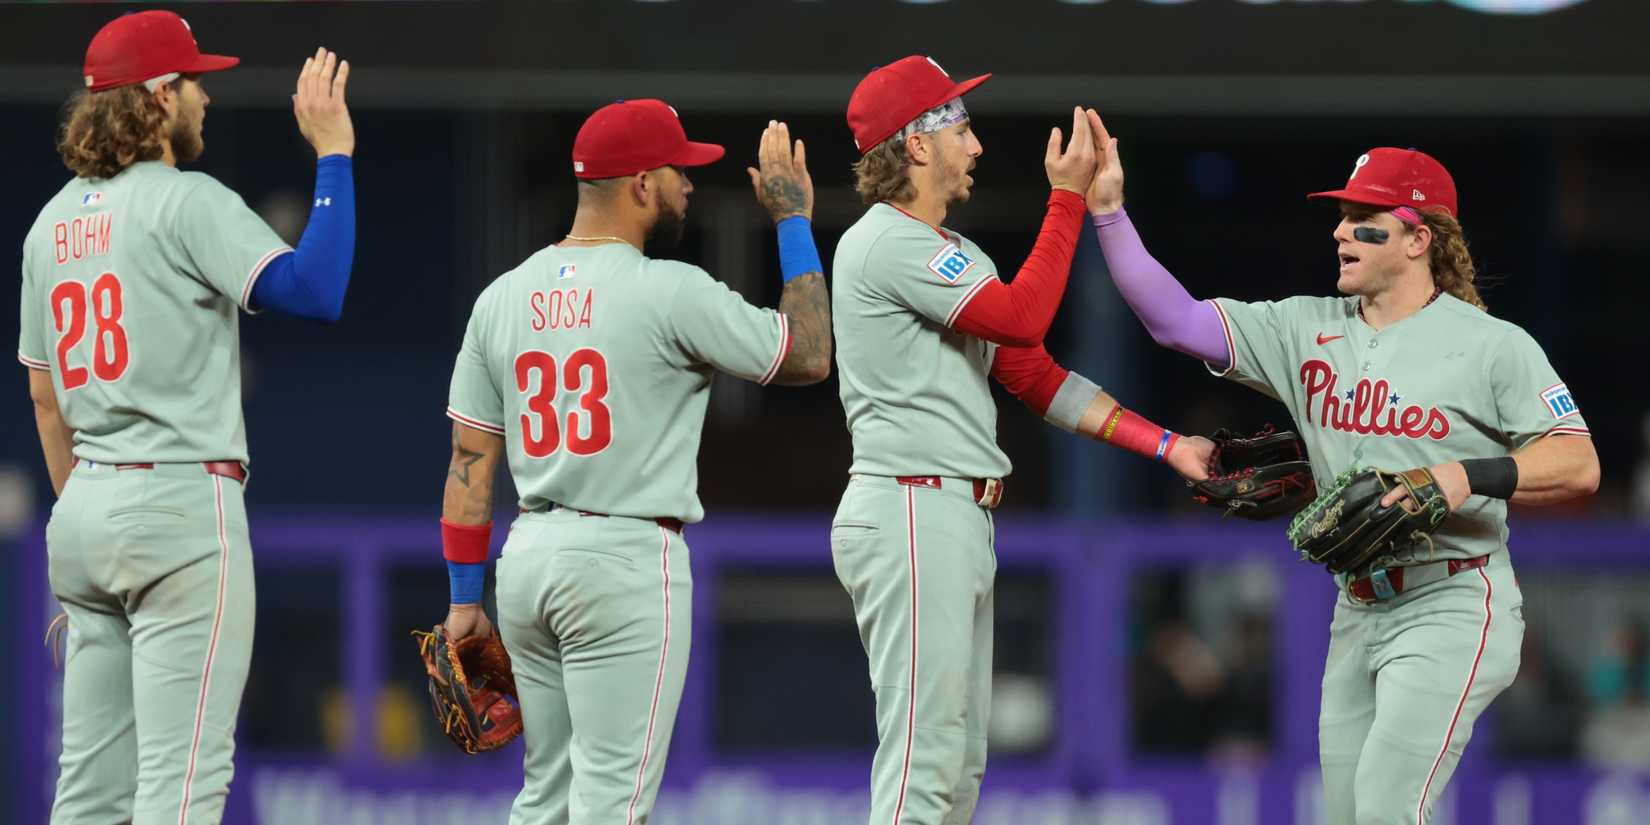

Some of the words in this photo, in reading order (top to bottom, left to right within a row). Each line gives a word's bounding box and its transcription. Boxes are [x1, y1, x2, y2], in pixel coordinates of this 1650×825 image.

[55, 213, 112, 265] BOHM
[937, 250, 973, 281] IBX
[50, 272, 129, 391] 28
[530, 287, 593, 332] SOSA
[514, 348, 614, 458] 33
[1300, 359, 1450, 440] Phillies
